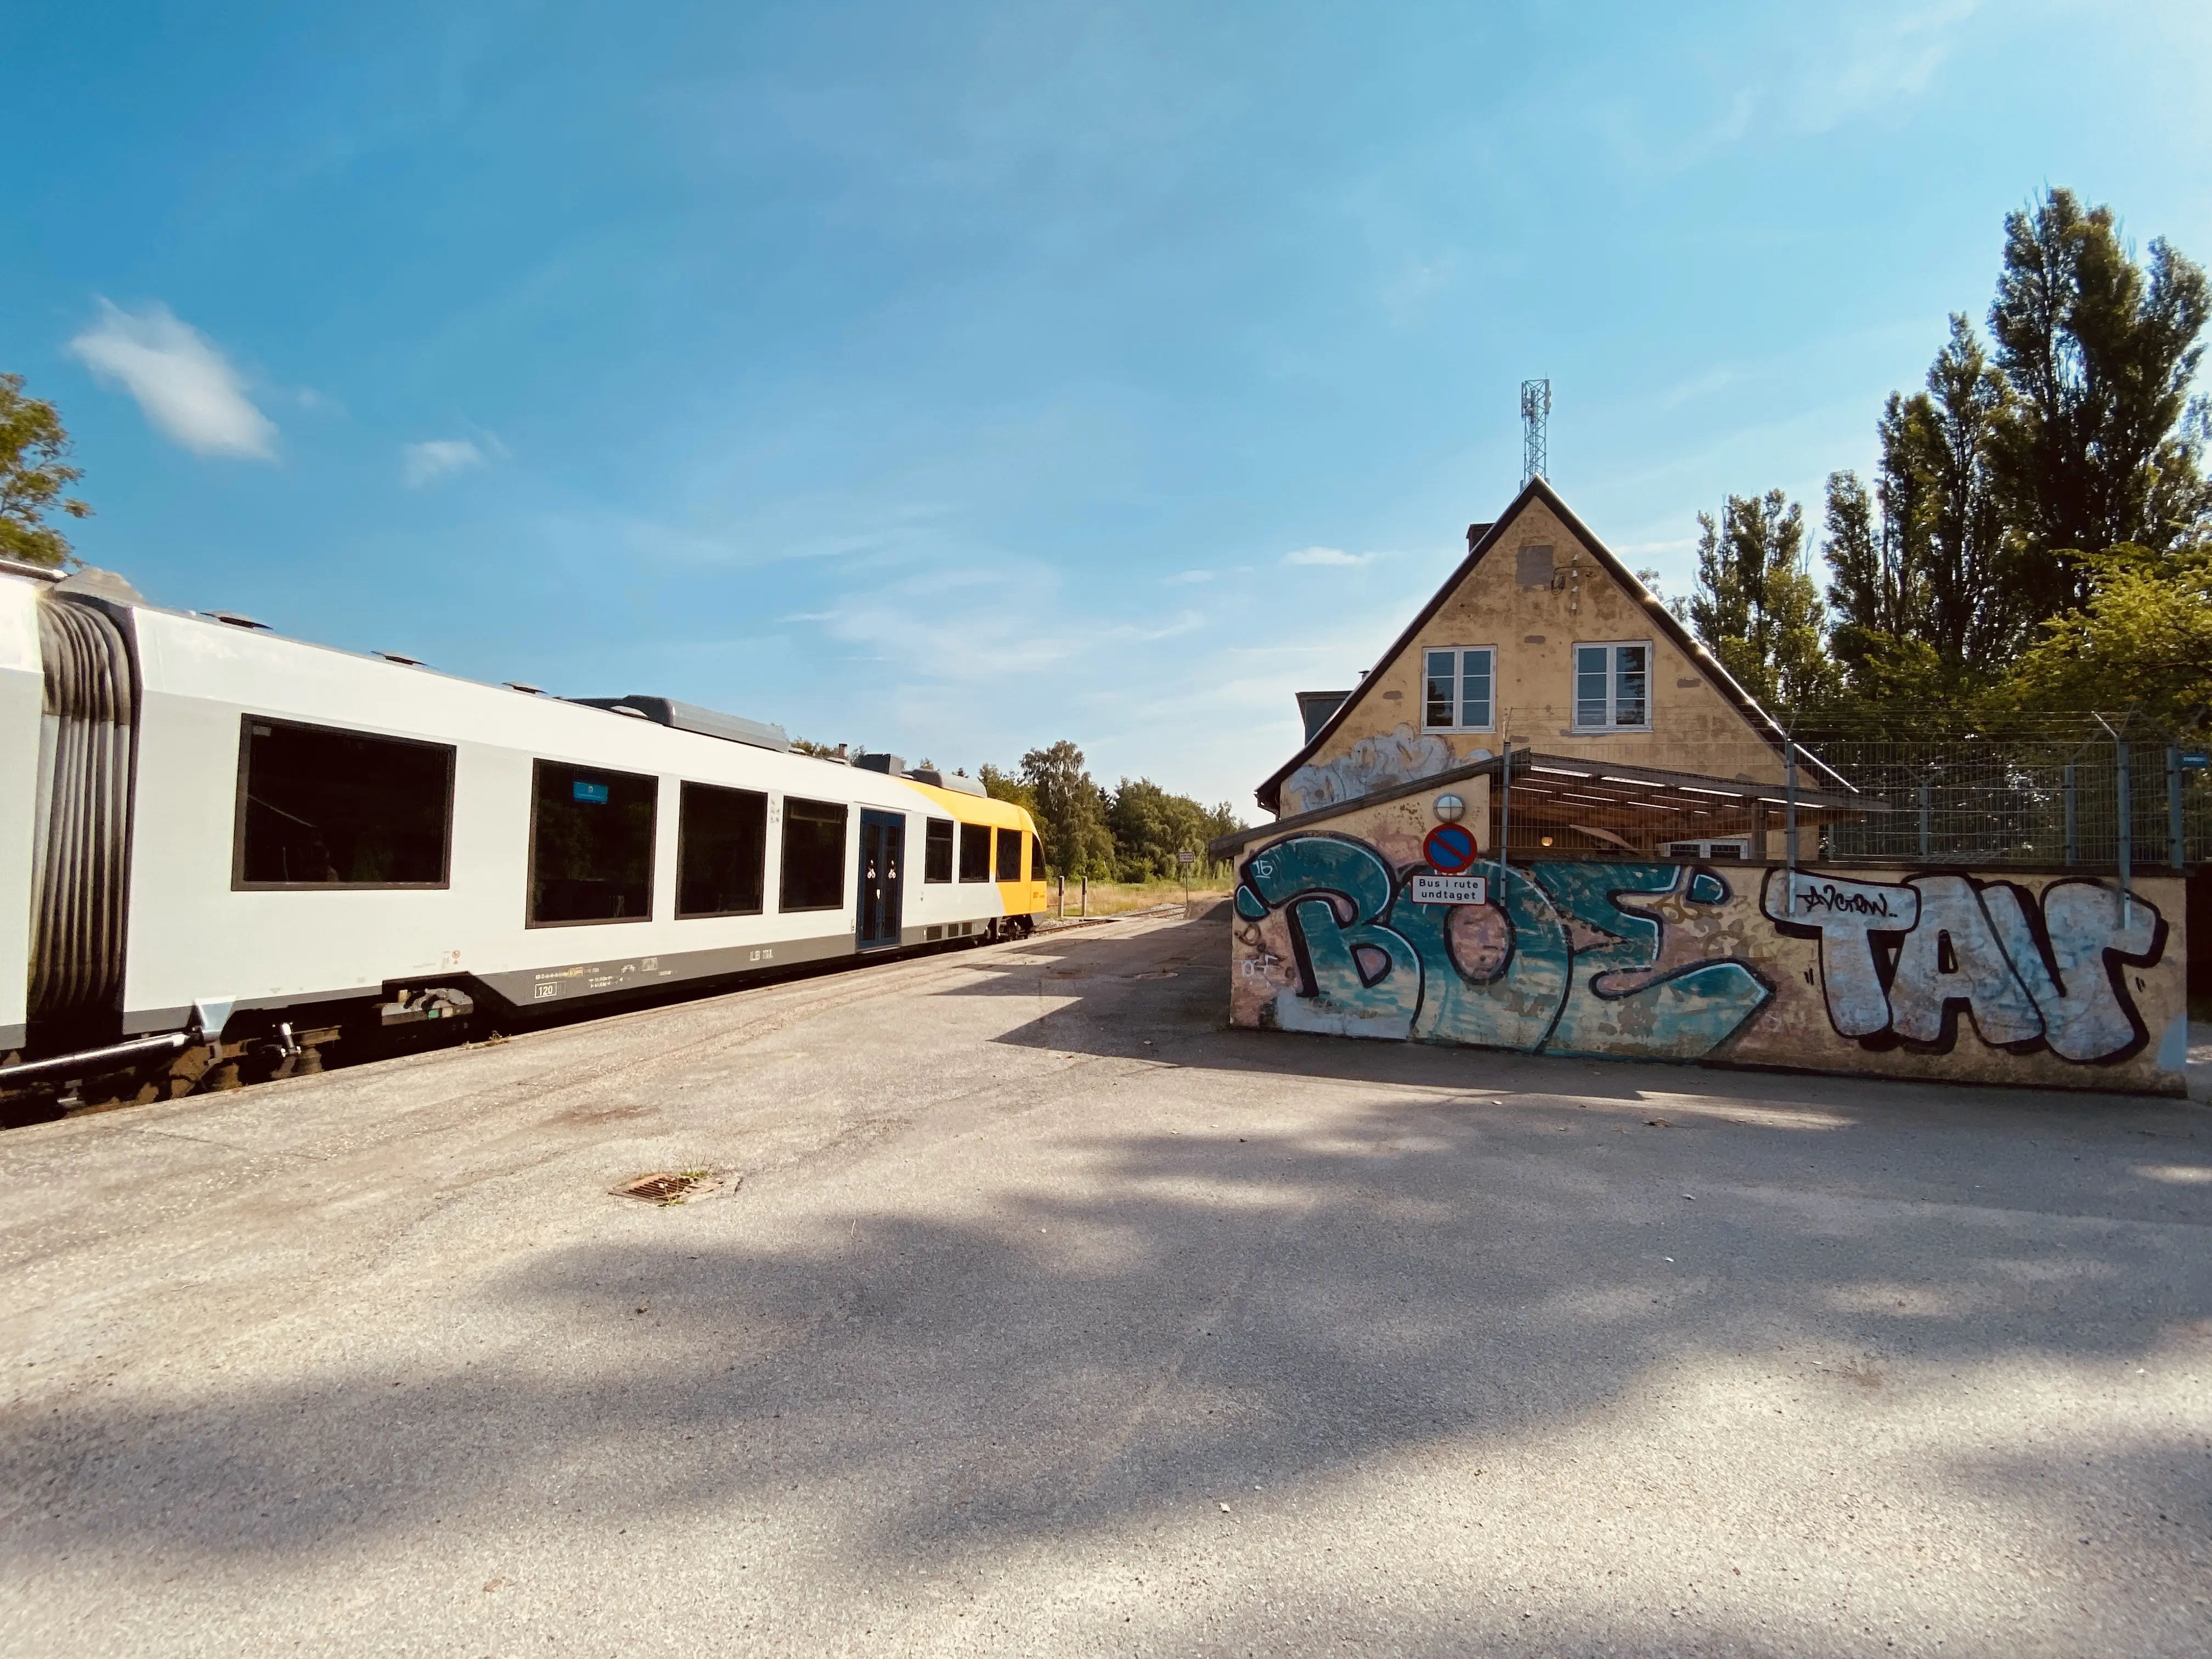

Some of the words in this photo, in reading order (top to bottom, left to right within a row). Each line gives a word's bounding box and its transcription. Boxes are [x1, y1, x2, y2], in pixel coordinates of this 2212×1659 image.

[1419, 878, 1440, 888] Bus
[1454, 879, 1479, 889] rute
[1421, 890, 1476, 901] undtaget
[538, 985, 554, 996] 120
